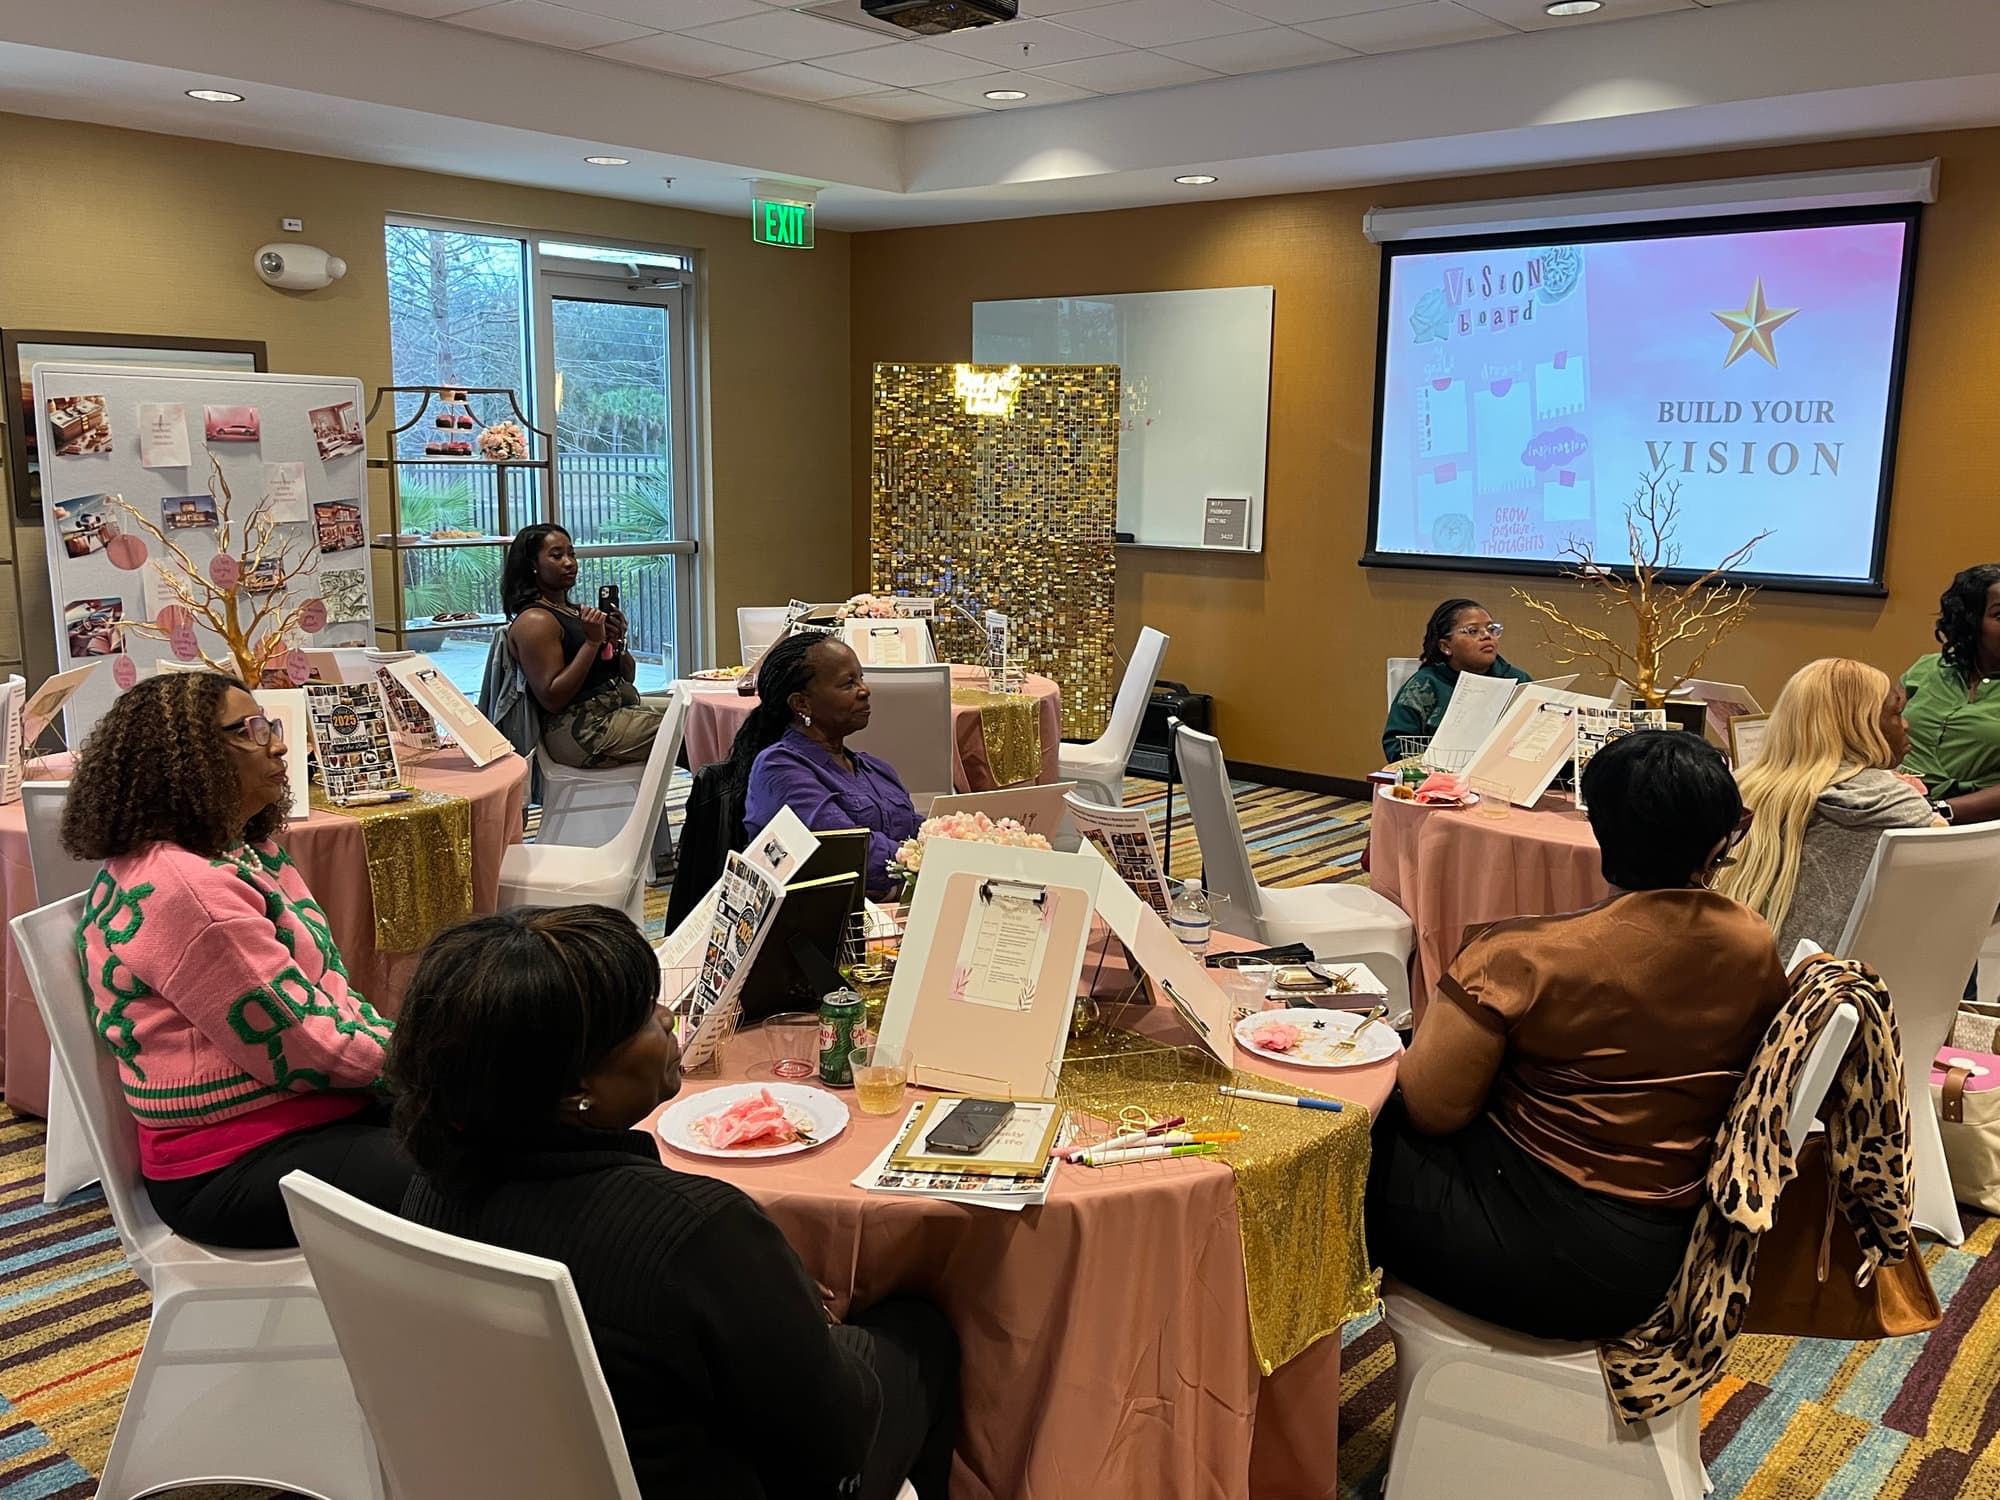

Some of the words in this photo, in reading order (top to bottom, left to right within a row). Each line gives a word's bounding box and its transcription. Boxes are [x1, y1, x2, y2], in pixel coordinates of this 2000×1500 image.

[765, 203, 806, 245] EXIT
[1461, 300, 1534, 332] board
[1657, 401, 1742, 423] BUILD
[1752, 400, 1835, 423] YOUR
[1644, 440, 1845, 477] VISION
[1495, 506, 1530, 523] GROW
[333, 715, 357, 727] 2025
